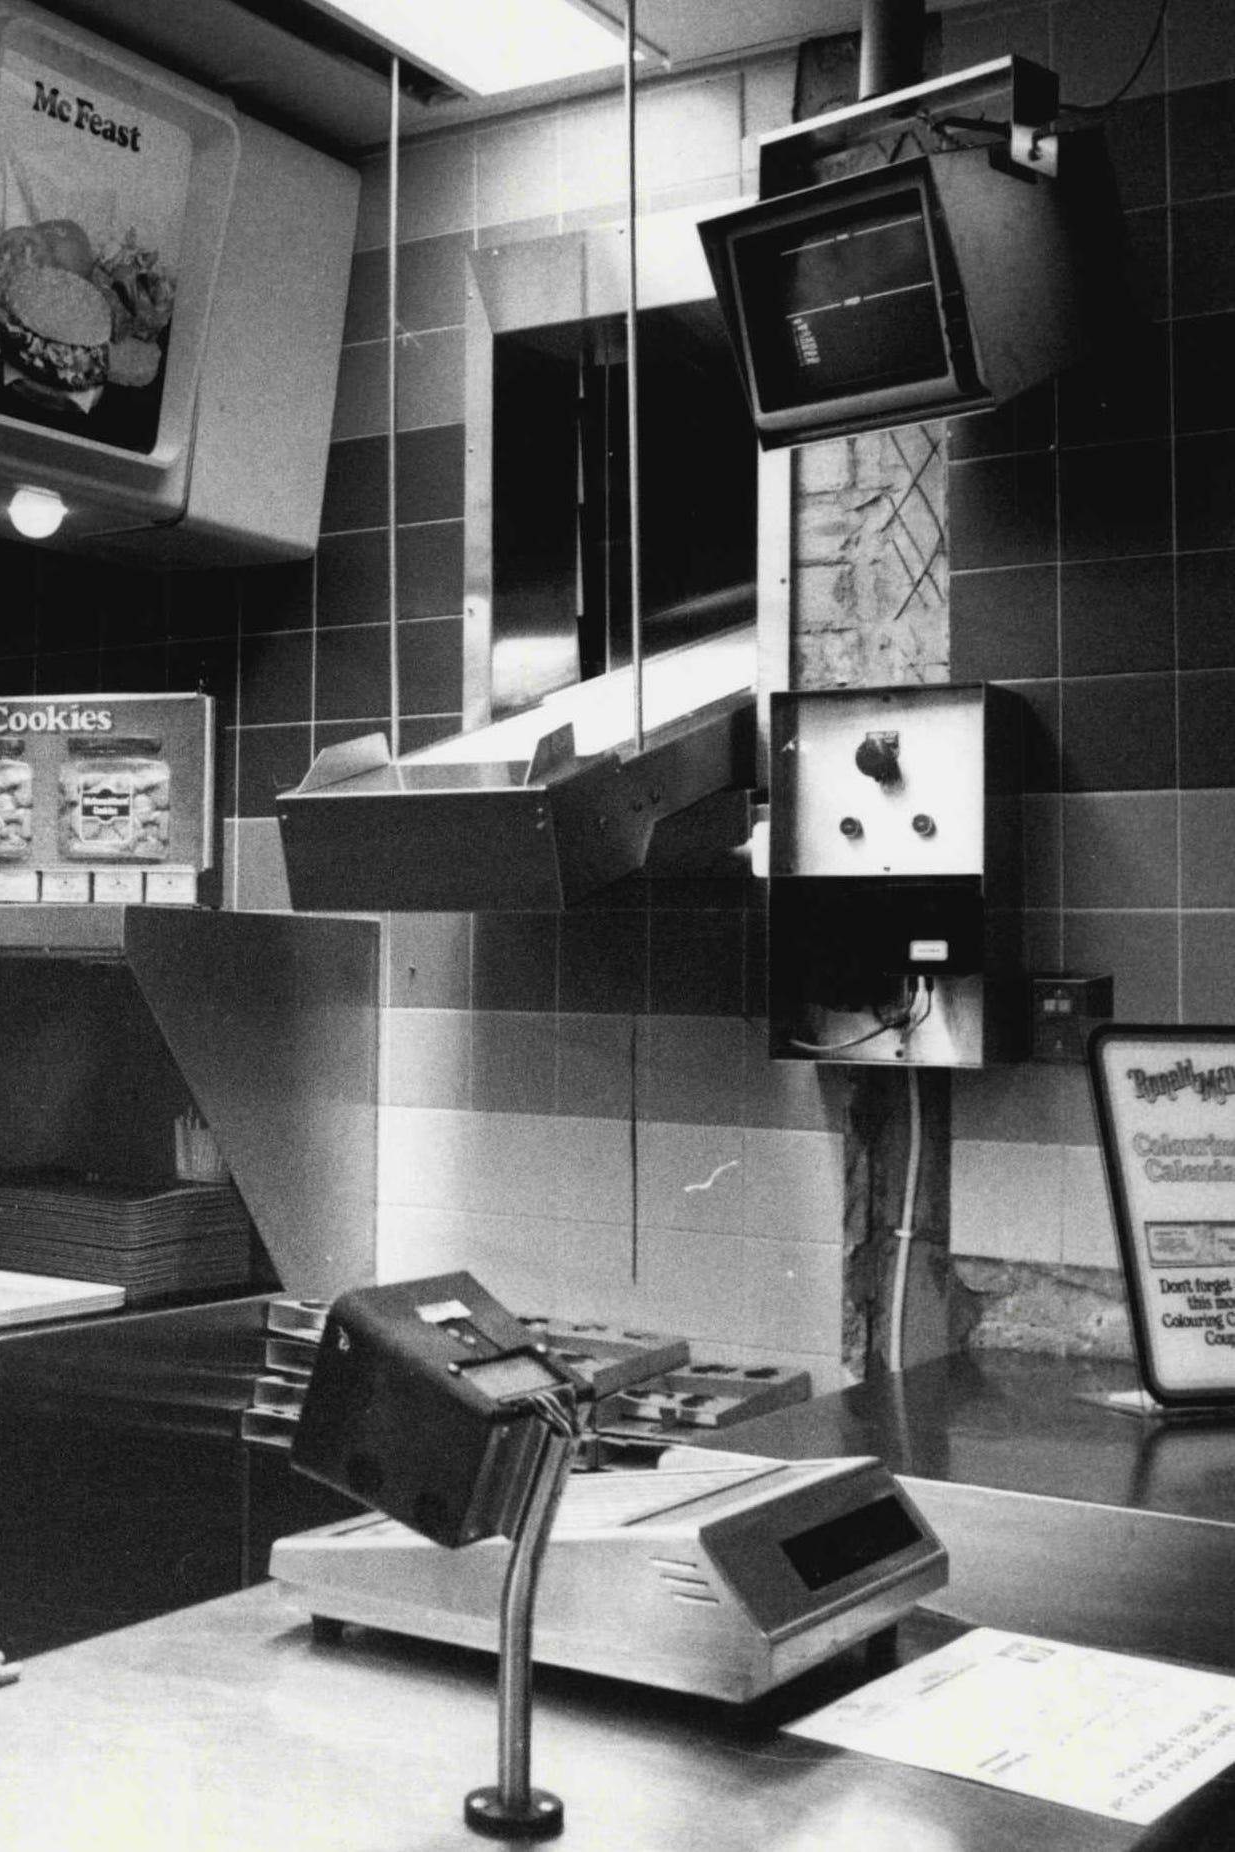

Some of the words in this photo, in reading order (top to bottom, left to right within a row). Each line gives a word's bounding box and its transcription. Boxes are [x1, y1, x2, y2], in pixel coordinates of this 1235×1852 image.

[1195, 1278, 1232, 1296] forget
[1187, 1295, 1213, 1310] this
[1162, 1313, 1225, 1331] Colouring
